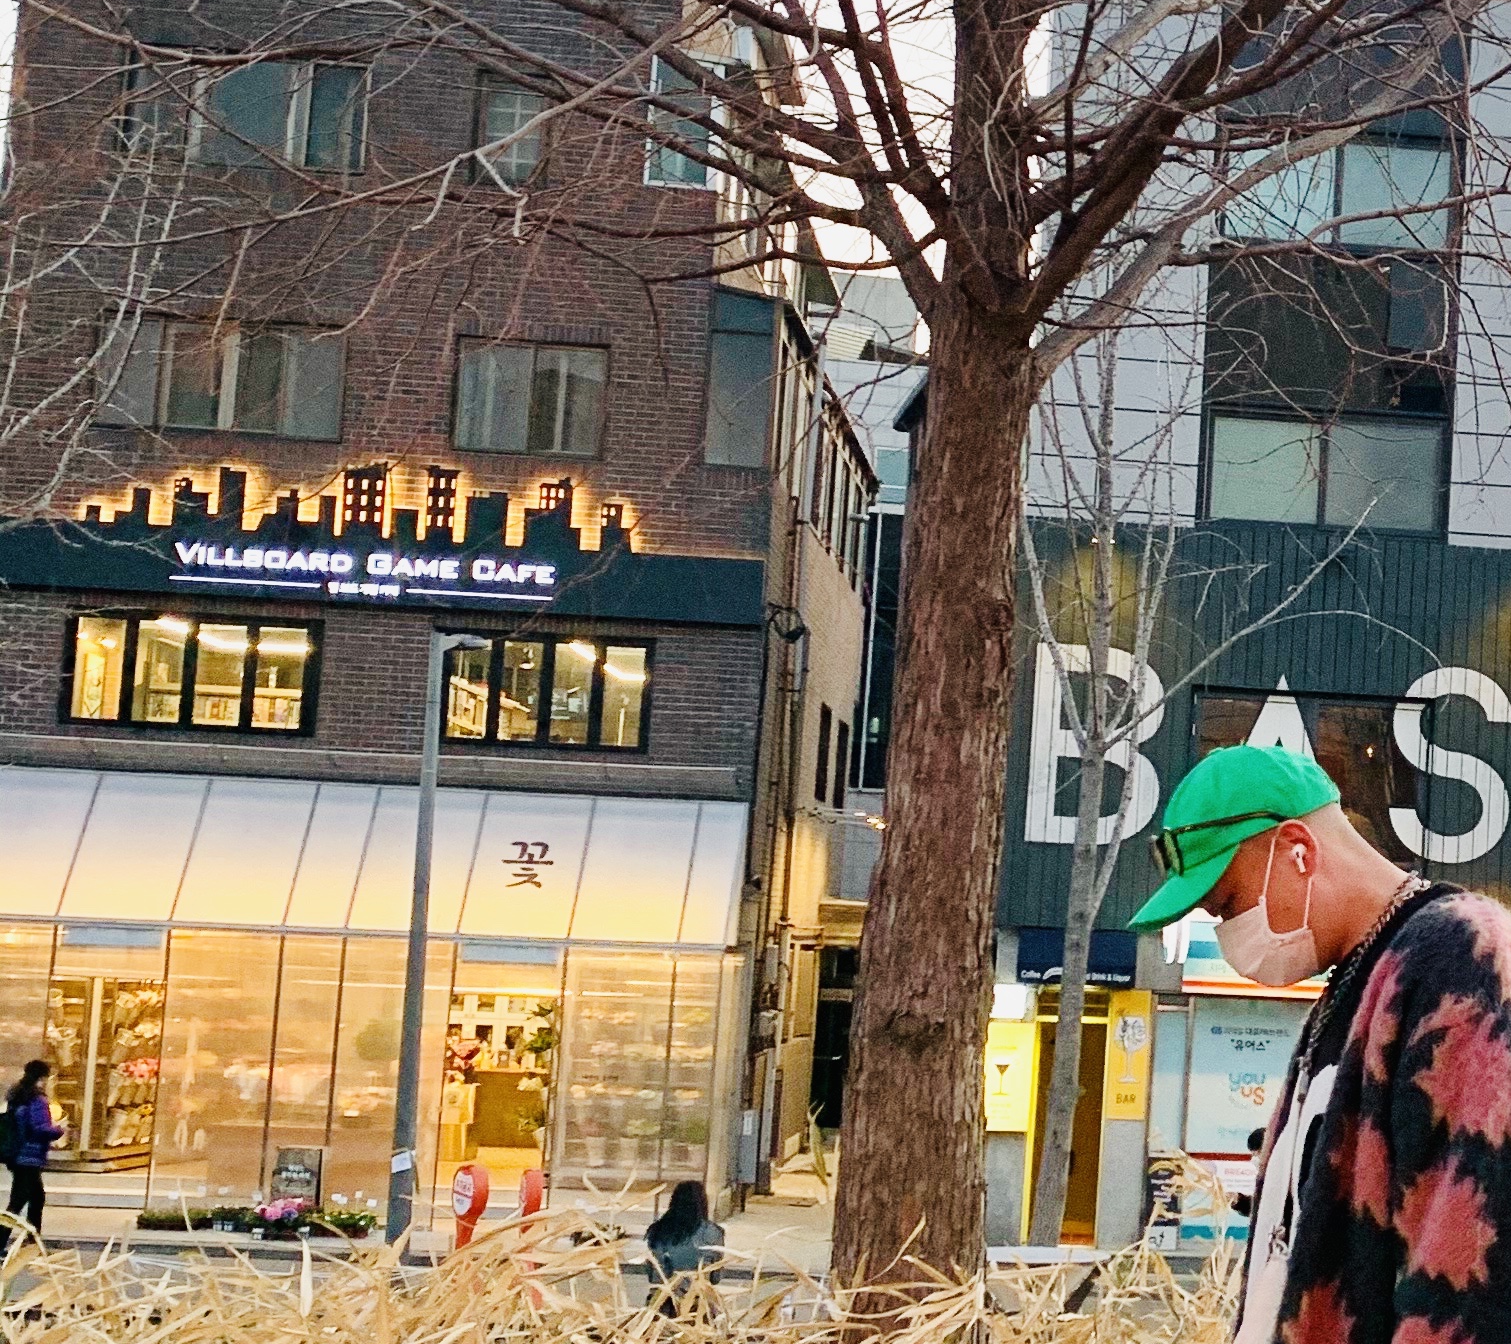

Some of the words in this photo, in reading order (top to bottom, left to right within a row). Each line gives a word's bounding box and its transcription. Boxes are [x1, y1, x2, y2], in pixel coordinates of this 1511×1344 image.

[175, 542, 353, 573] VILLBOARD
[366, 552, 460, 580] GAME
[472, 558, 556, 585] CAFE
[501, 841, 554, 889] 꽃
[1115, 1093, 1137, 1105] BAR
